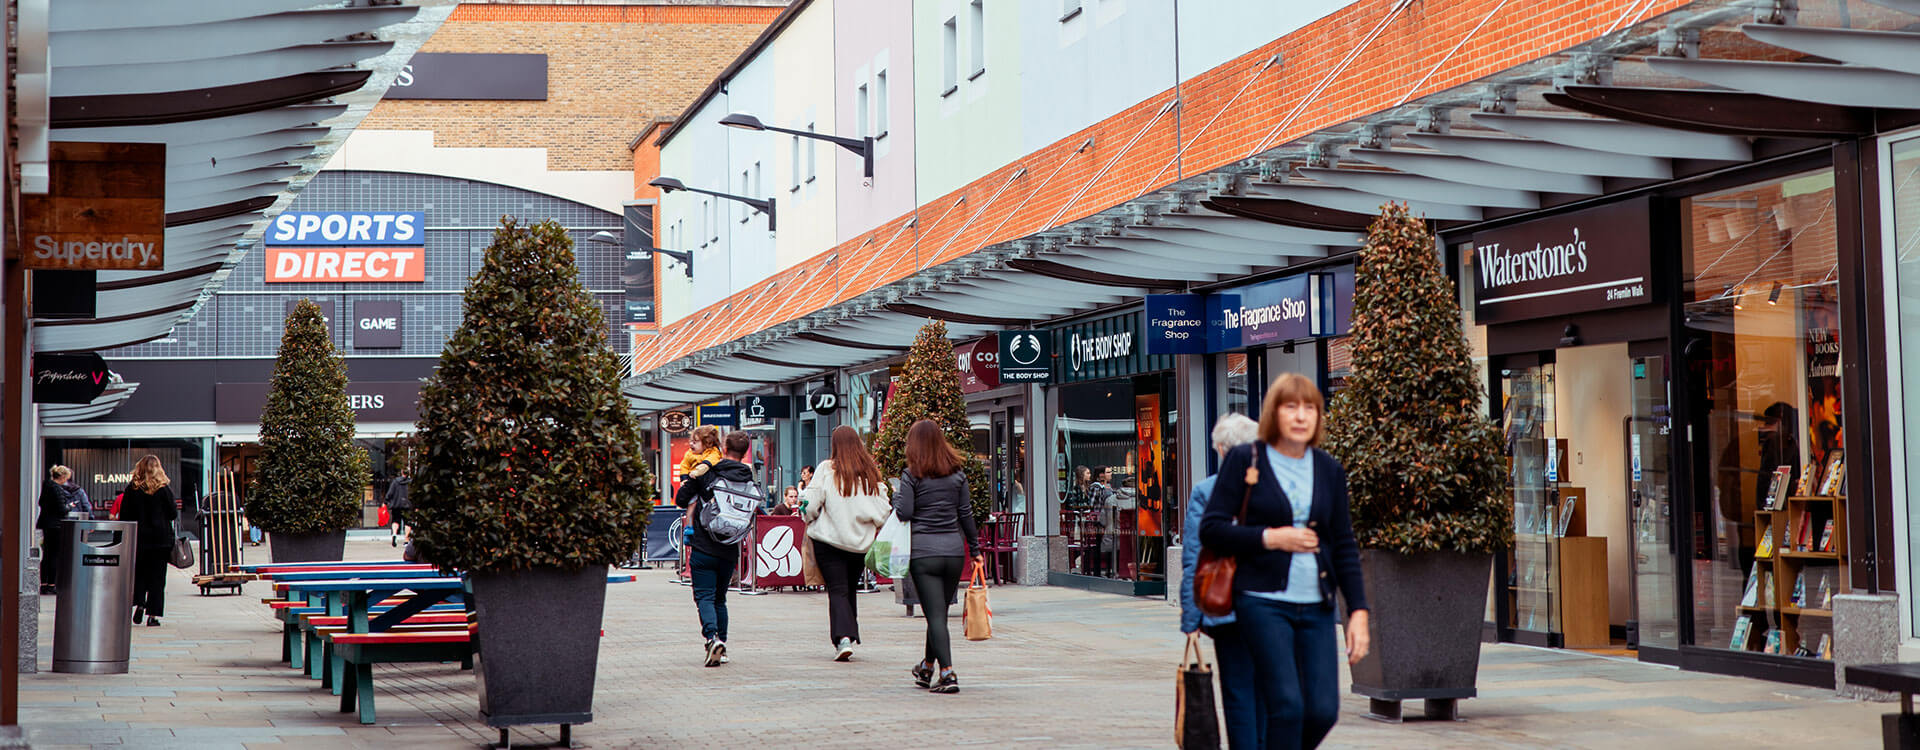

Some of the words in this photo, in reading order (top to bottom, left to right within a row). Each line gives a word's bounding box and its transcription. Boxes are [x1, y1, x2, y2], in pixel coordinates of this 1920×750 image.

[274, 214, 415, 241] SPORTS
[34, 235, 159, 266] Superdry.
[1478, 227, 1587, 289] Waterstone's
[274, 251, 414, 278] DIRECT
[1168, 308, 1186, 316] The
[1223, 309, 1239, 330] The
[1240, 304, 1281, 331] Fragrance
[1282, 297, 1306, 323] Shop
[359, 318, 397, 330] GAME
[1151, 318, 1202, 329] Fragrance
[1165, 330, 1190, 340] Shop
[1808, 327, 1828, 343] NEW
[1081, 338, 1095, 362] THE
[1095, 335, 1112, 360] BODY
[1113, 331, 1131, 358] SHOP
[816, 394, 836, 409] JD
